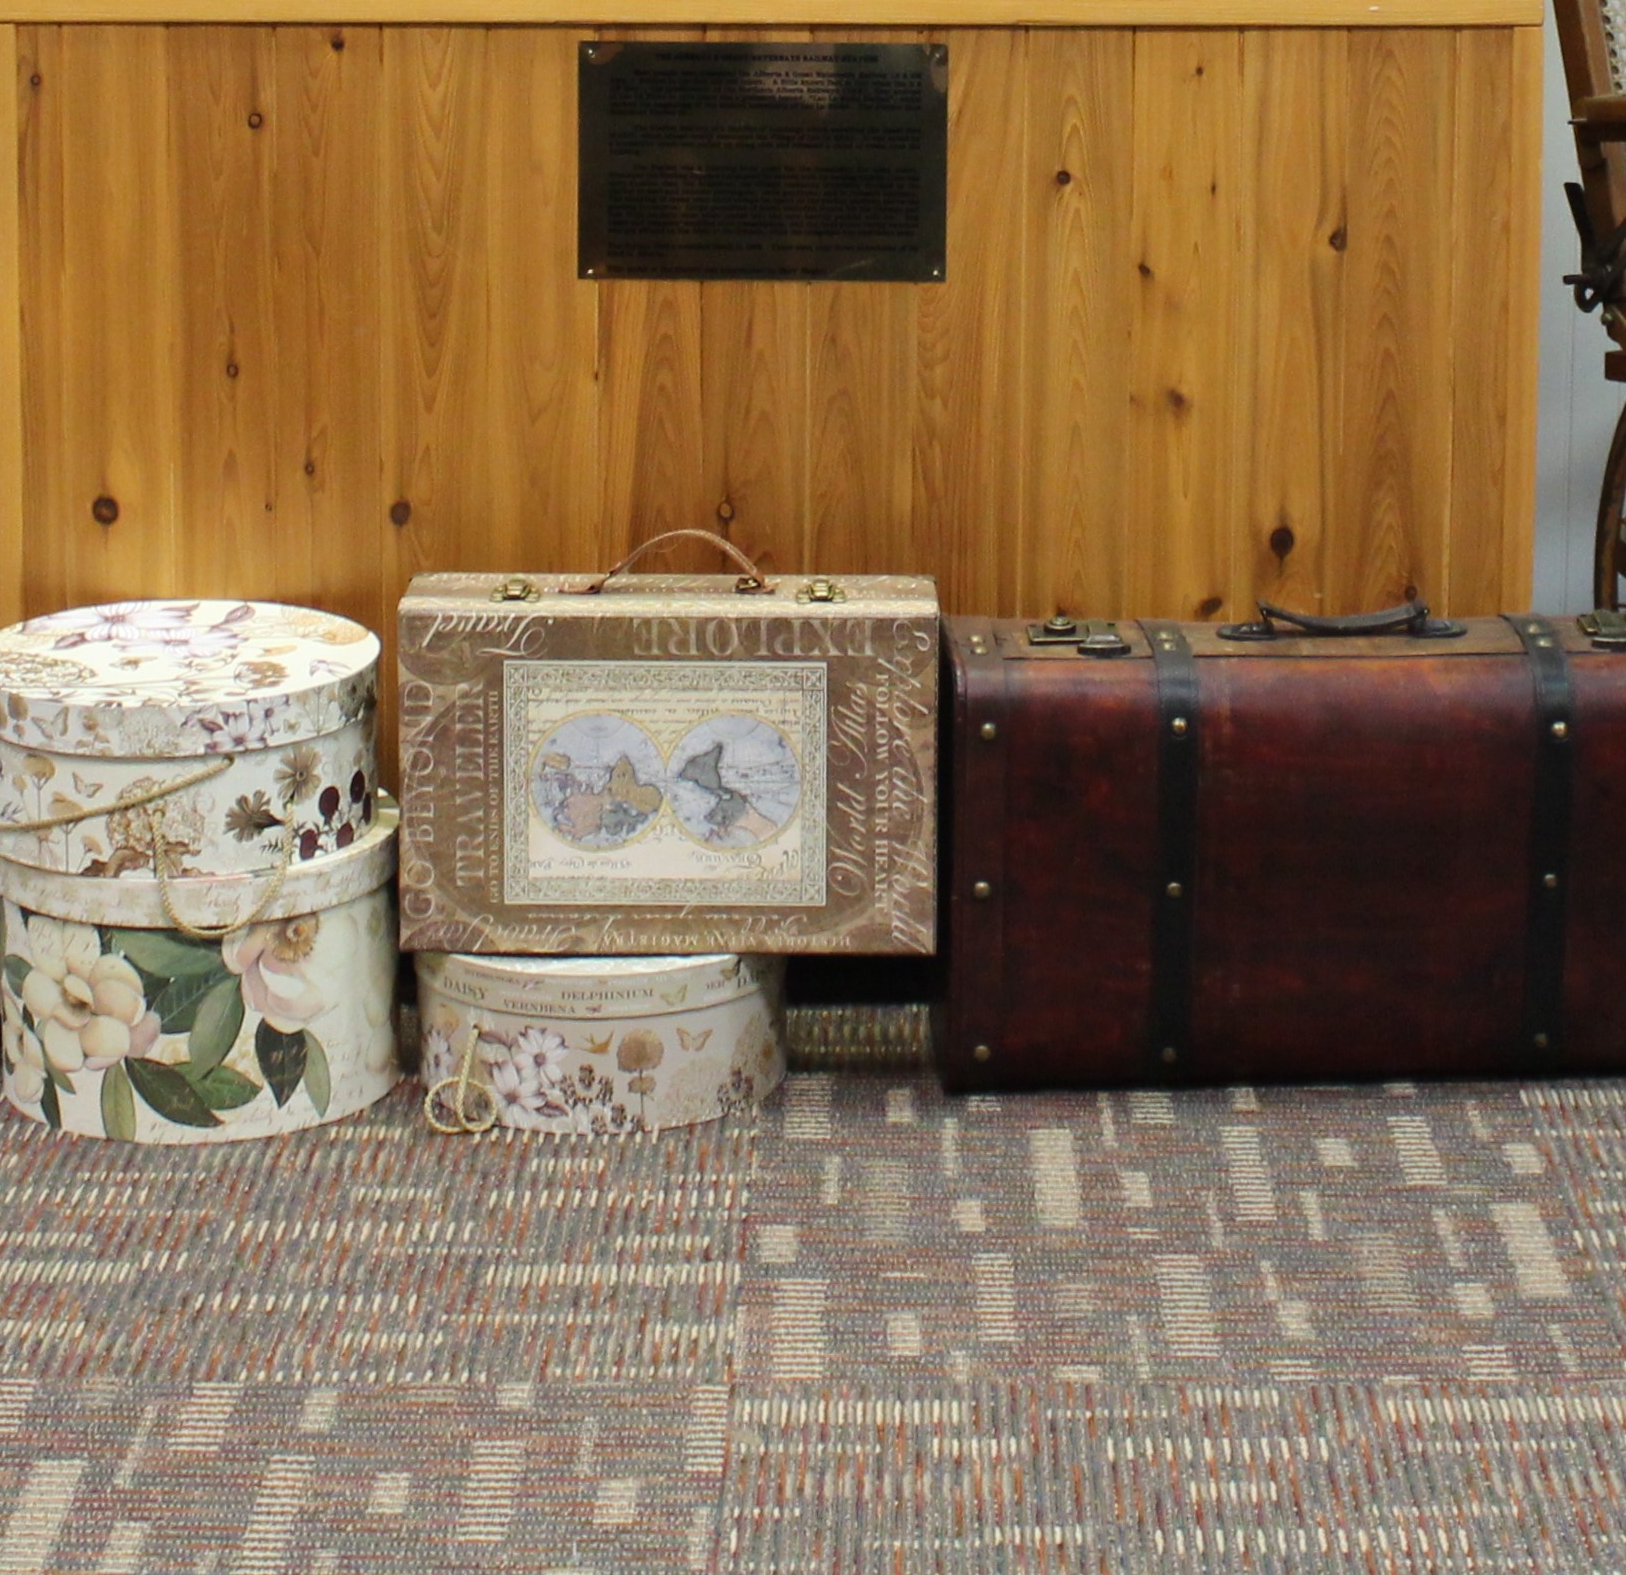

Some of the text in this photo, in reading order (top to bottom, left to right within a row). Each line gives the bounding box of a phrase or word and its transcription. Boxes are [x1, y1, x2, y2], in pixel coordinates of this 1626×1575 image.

[422, 611, 554, 657] Travel
[632, 618, 874, 657] EXPLORE
[403, 681, 435, 919] GO BEYOND
[455, 680, 485, 887] TRAVELER
[489, 690, 500, 903] GO TO ENDS OF THE EARTH
[829, 681, 868, 897] World Atlas
[875, 673, 889, 914] FOLLOW YOUR HEART
[877, 620, 930, 954] Explore the World
[443, 978, 488, 1001] DAISY
[561, 988, 655, 1001] DELPHINIUM
[764, 934, 851, 948] HISTORIA
